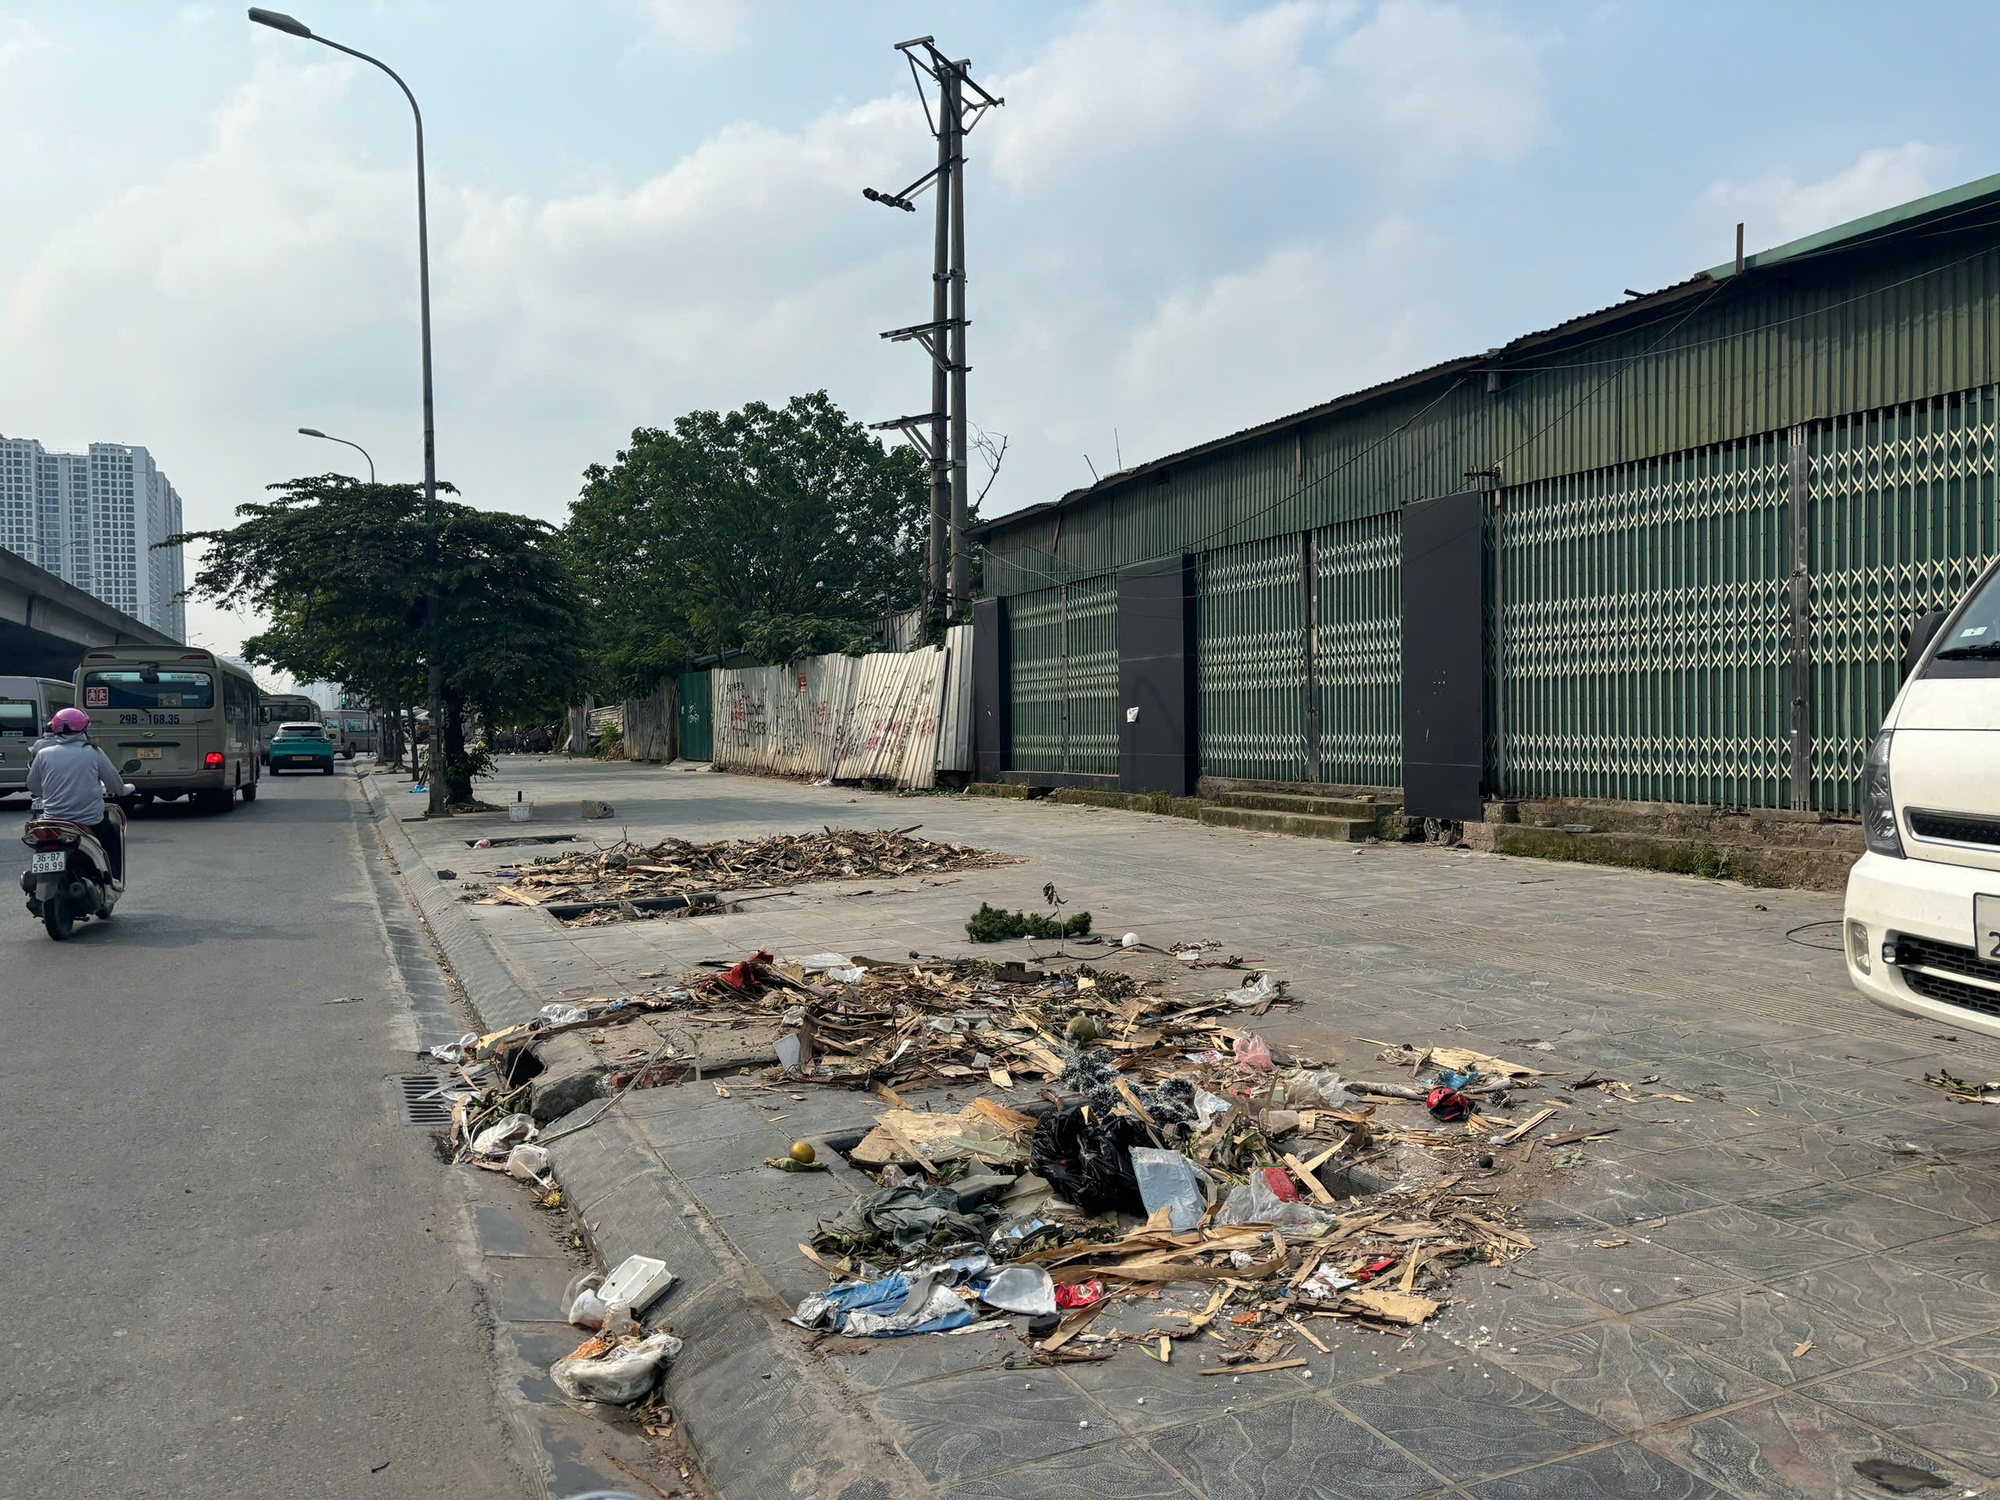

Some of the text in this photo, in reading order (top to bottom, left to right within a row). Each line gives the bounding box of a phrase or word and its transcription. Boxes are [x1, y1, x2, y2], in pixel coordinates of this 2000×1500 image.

[120, 714, 138, 725] 29B
[148, 714, 180, 725] 168.35
[33, 861, 64, 873] 598.99
